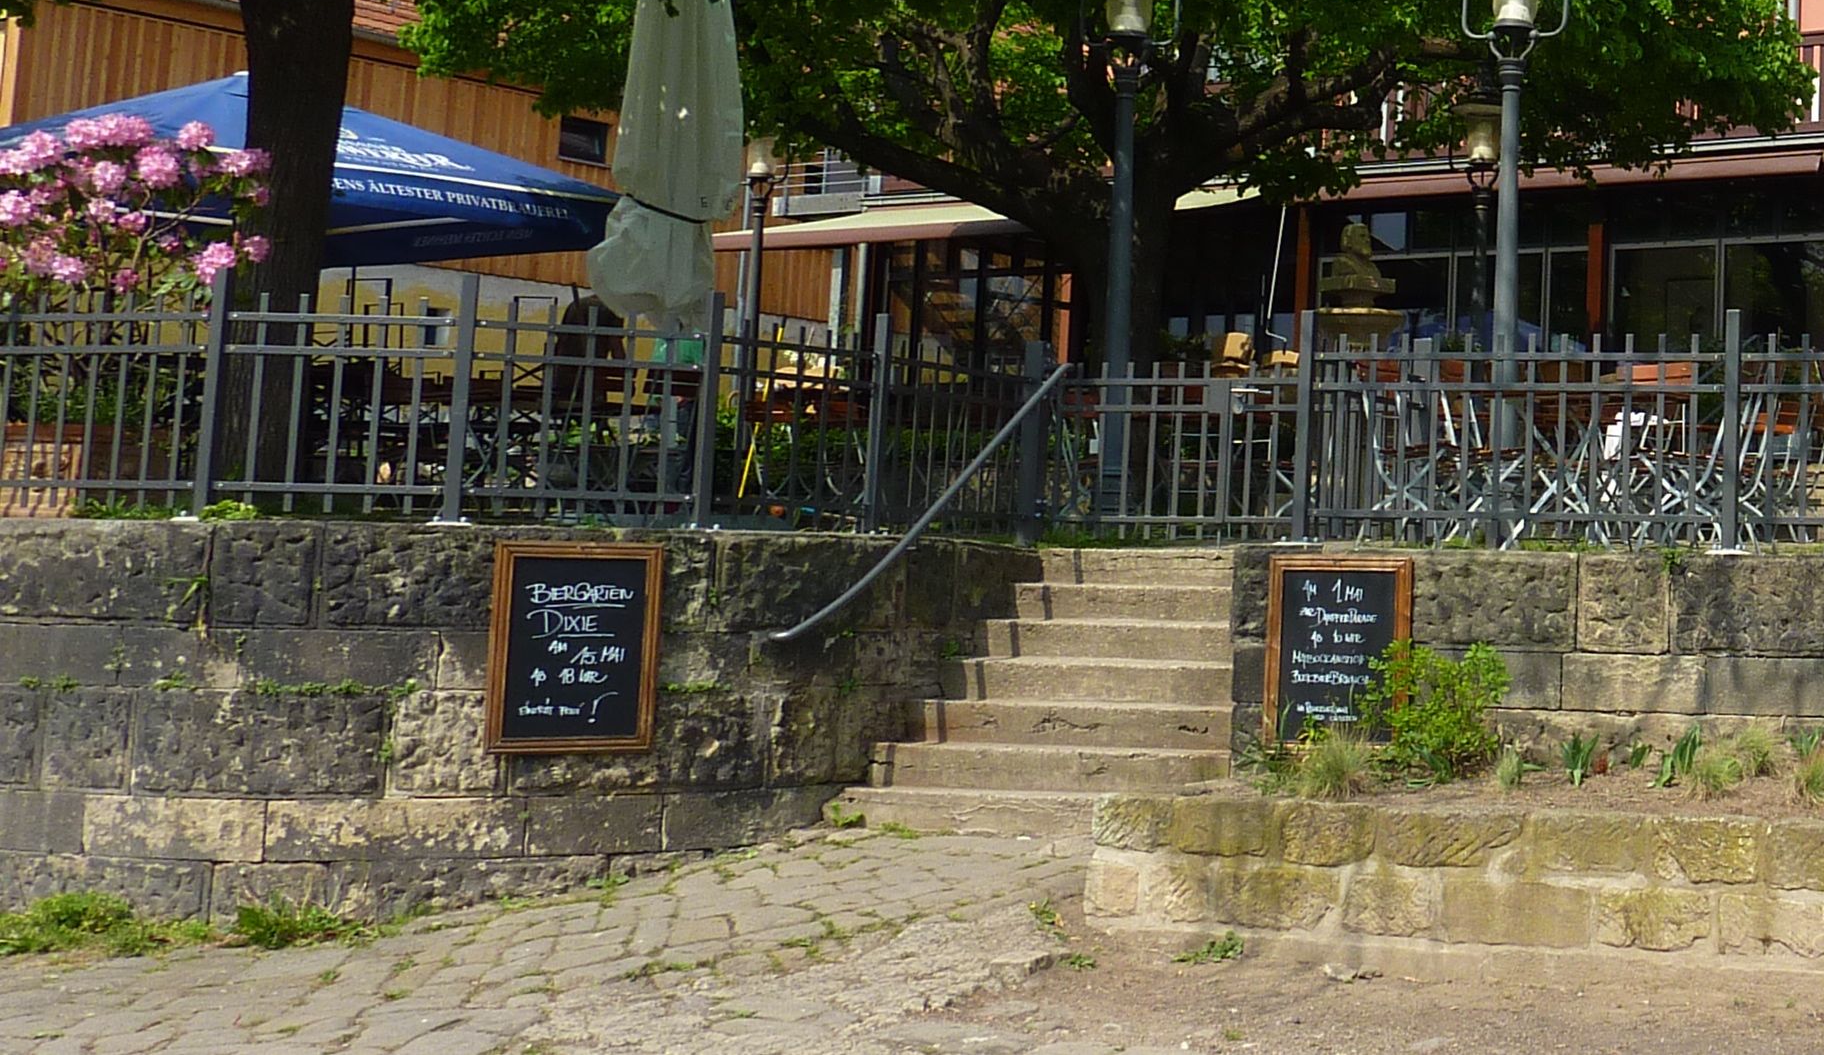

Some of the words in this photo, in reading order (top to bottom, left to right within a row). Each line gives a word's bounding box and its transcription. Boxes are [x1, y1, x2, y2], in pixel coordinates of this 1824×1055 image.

[446, 191, 569, 219] PRIVATBRAUEREI
[525, 582, 634, 605] BIERGARTEN
[1344, 585, 1364, 602] MAI
[527, 610, 598, 638] DIXIE
[600, 645, 625, 664] MAI
[558, 667, 575, 684] 18
